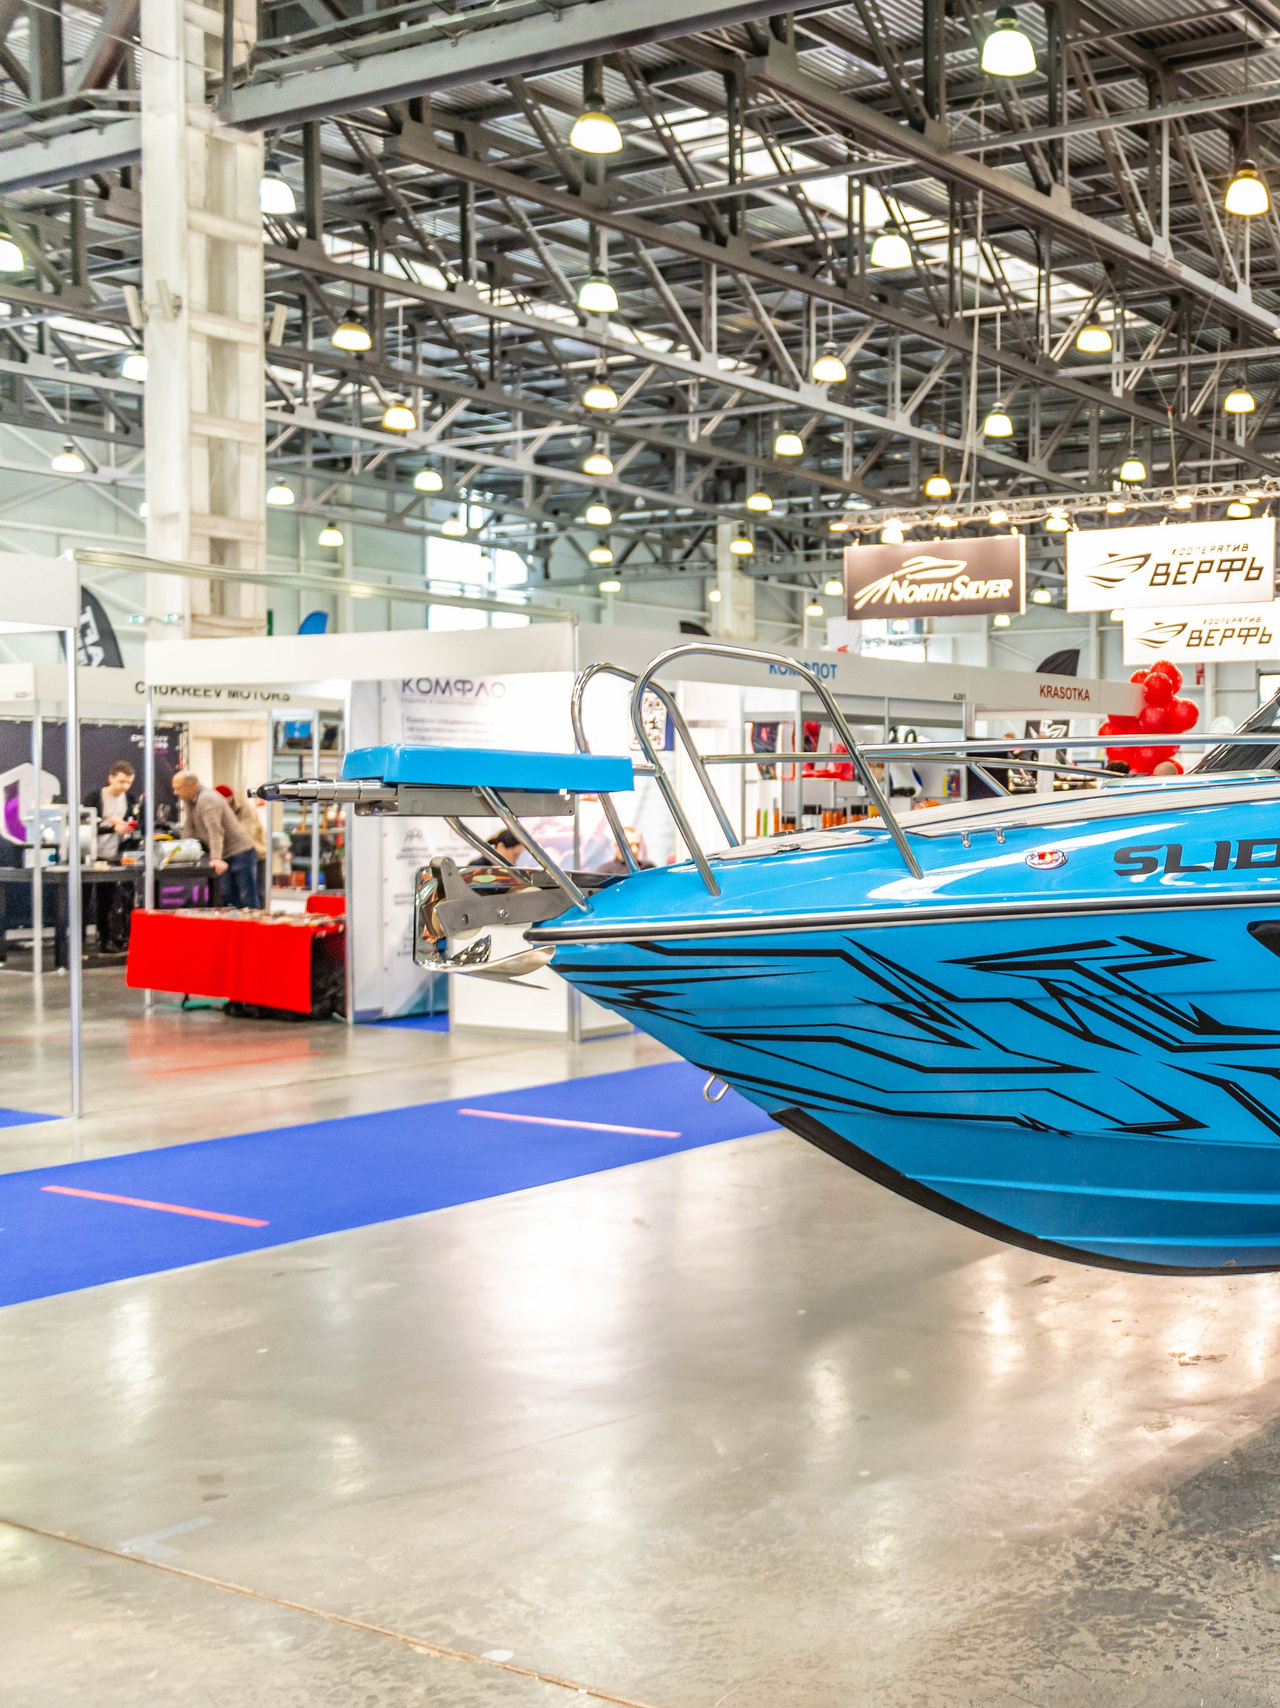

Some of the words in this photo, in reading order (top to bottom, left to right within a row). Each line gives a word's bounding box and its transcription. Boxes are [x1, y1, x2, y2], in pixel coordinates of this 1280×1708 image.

[1171, 543, 1249, 556] КООПЕРАТИВ
[1149, 556, 1264, 587] ВЕРФЬ
[1203, 616, 1262, 625] КООПЕРАТИВ
[1186, 626, 1273, 647] ВЕРФЬ
[1040, 684, 1091, 701] KRASOTKA
